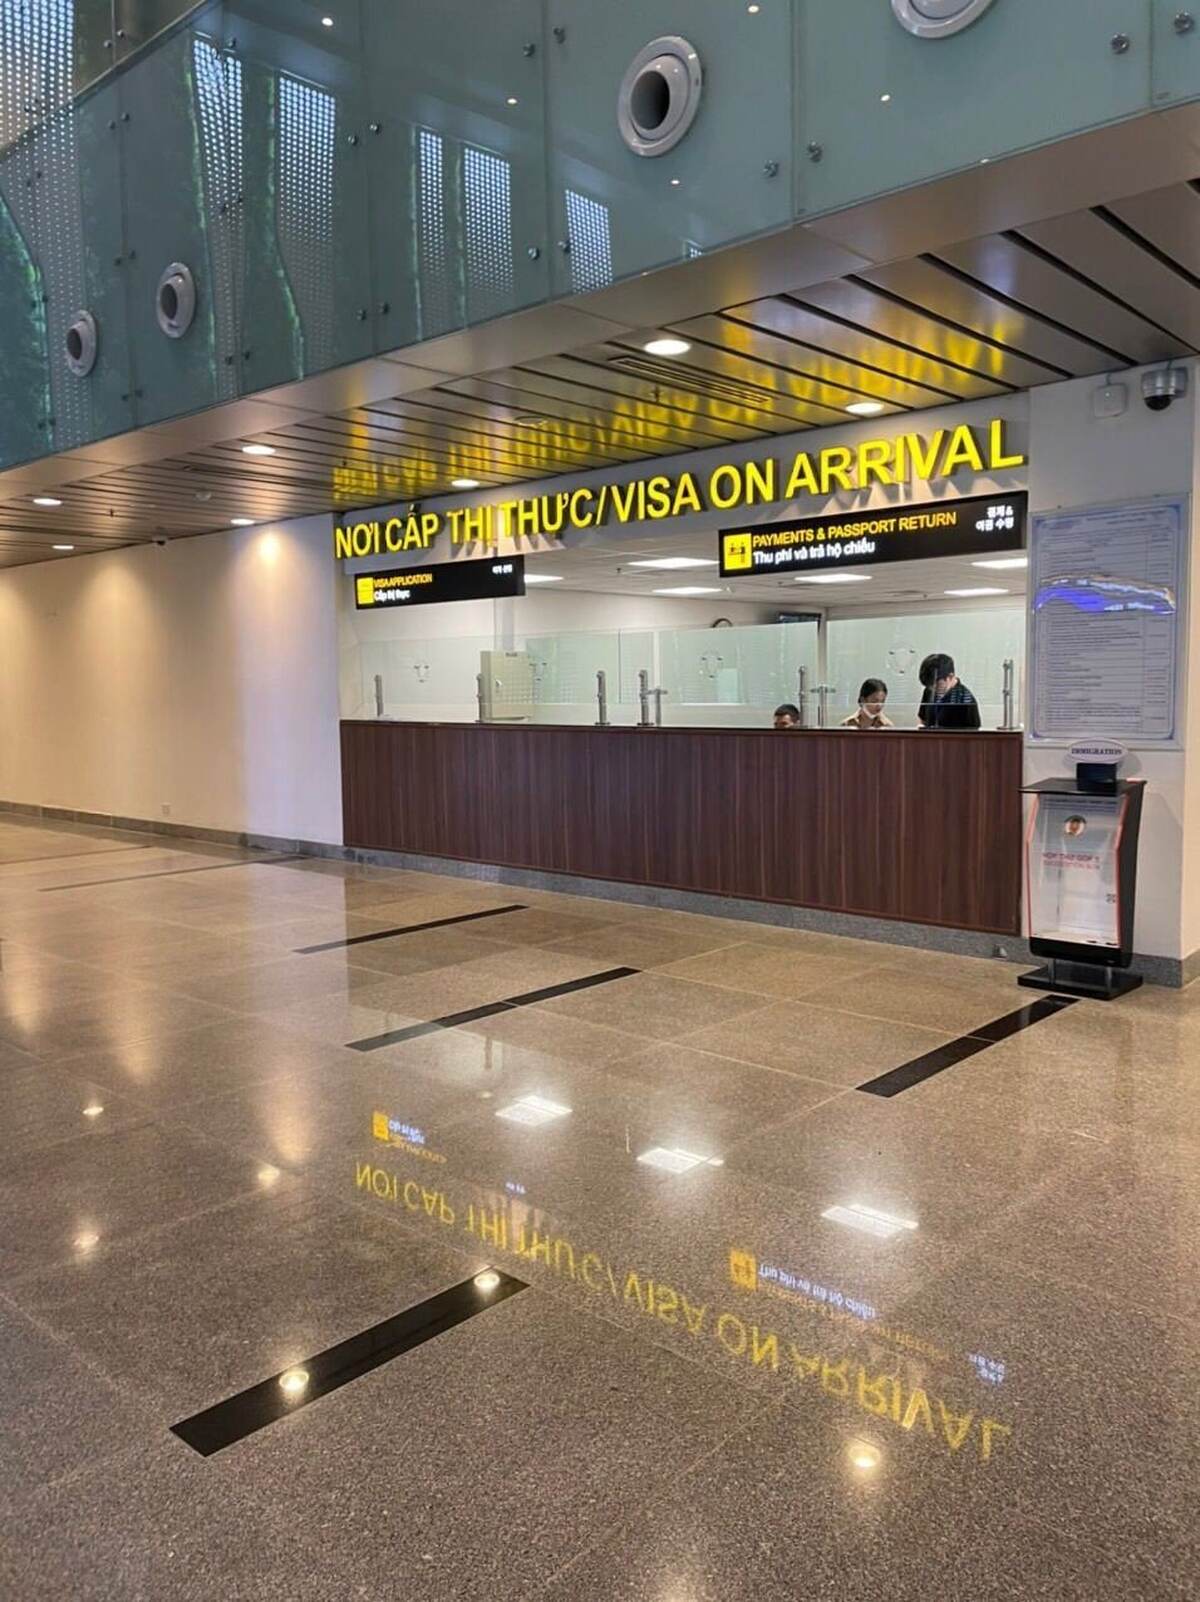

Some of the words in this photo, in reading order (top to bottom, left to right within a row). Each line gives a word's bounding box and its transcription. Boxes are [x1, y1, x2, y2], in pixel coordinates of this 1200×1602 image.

[335, 521, 381, 559] NƠI
[385, 503, 440, 553] CẤP
[709, 457, 774, 510] ON
[785, 419, 1025, 499] ARRIVAL
[752, 528, 814, 548] PAYMENTS
[816, 526, 826, 541] &
[827, 517, 897, 539] PASSPORT
[898, 511, 957, 531] RETURN
[752, 550, 774, 565] Thu
[775, 547, 793, 565] phí
[793, 545, 809, 560] và
[826, 541, 842, 558] hộ
[373, 577, 389, 588] VISA
[389, 572, 433, 587] APPLICATION
